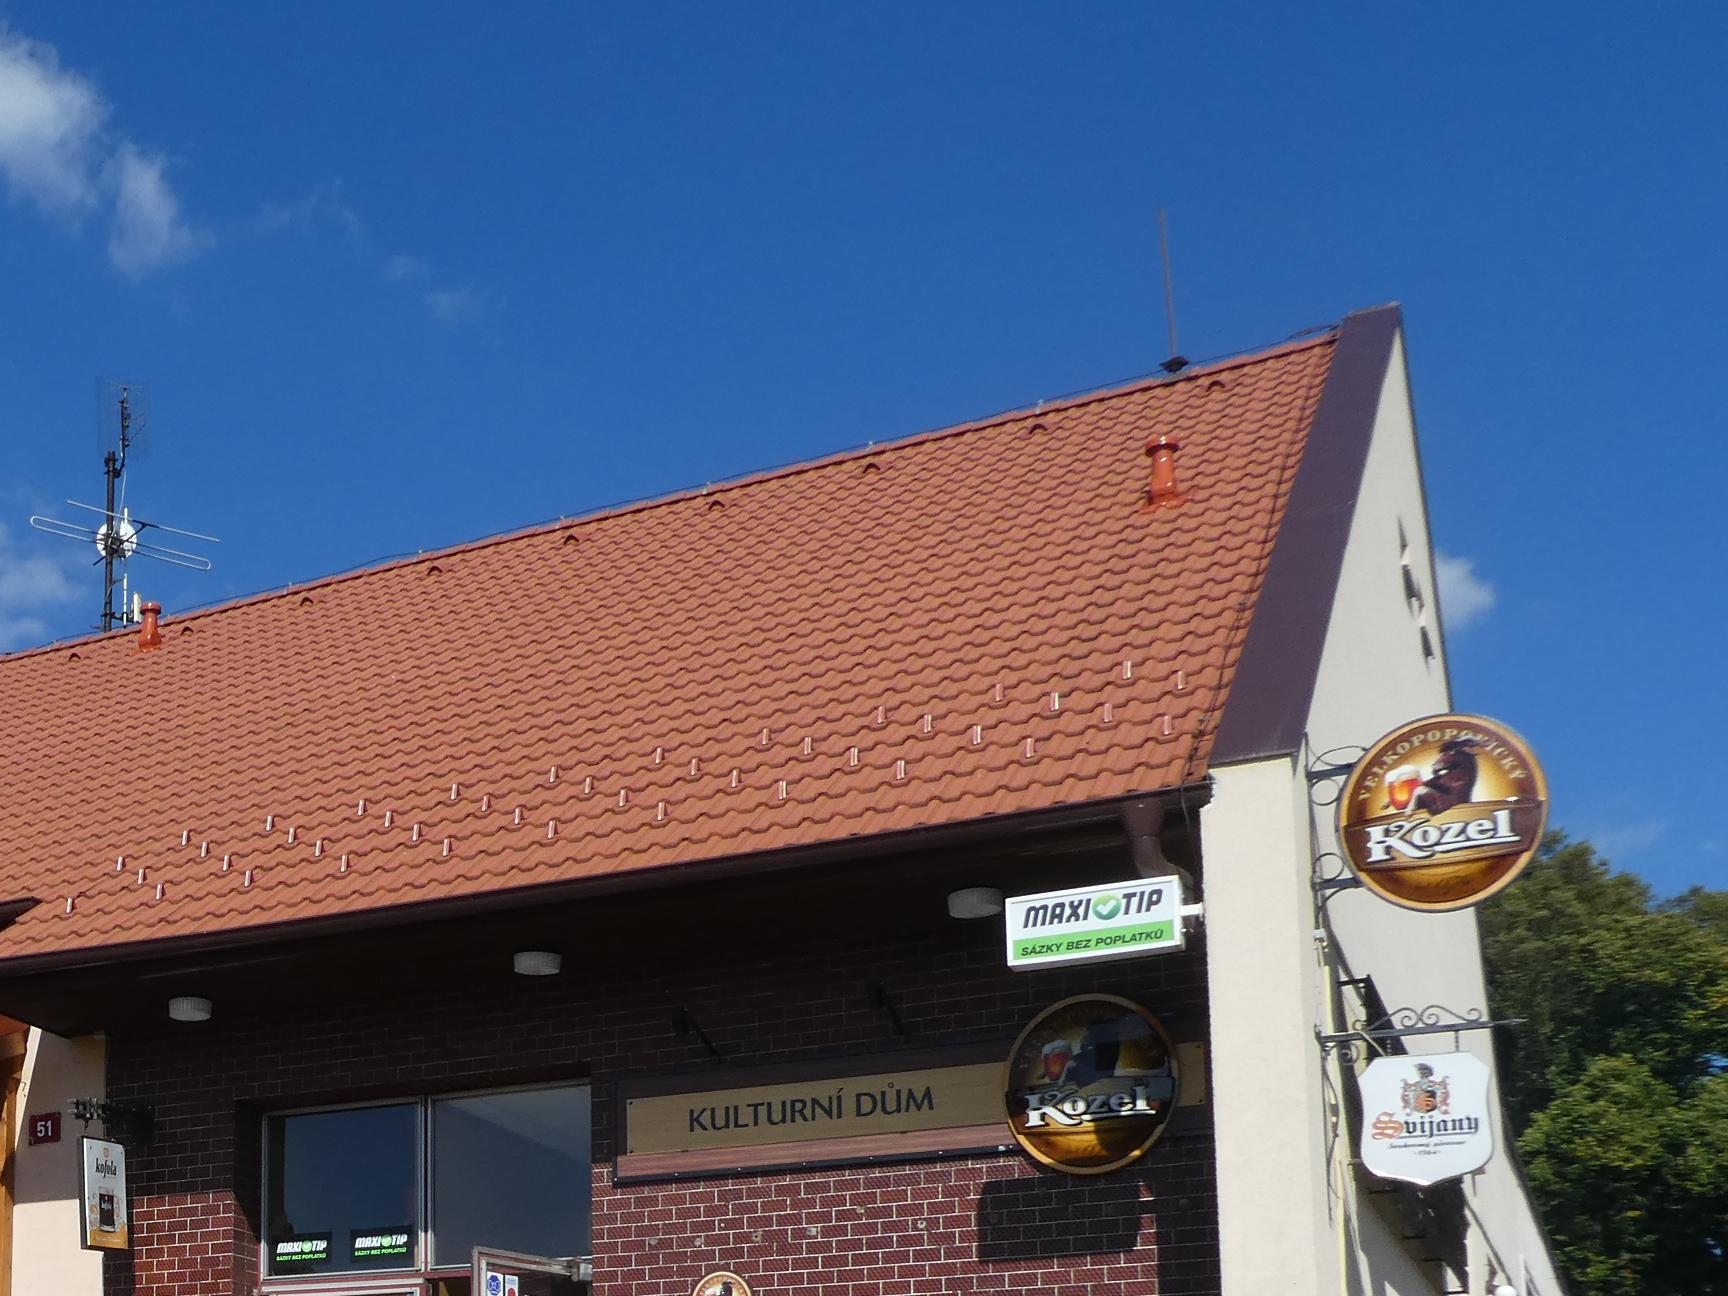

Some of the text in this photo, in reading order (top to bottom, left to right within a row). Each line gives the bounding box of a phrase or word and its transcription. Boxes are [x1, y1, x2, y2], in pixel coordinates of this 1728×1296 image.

[1365, 809, 1521, 863] Kozel
[1023, 887, 1164, 929] MAXI TIP
[1021, 928, 1164, 957] SÁZKY BEZ POPLATKŮ
[688, 1081, 935, 1133] KULTURNÍ DŮM
[1024, 1085, 1157, 1128] Kozel
[36, 1120, 53, 1137] 51
[1371, 1111, 1479, 1140] Svijany
[95, 1158, 117, 1178] kofola
[276, 1239, 328, 1254] MAXI TIP
[355, 1234, 408, 1248] MAXI TIP
